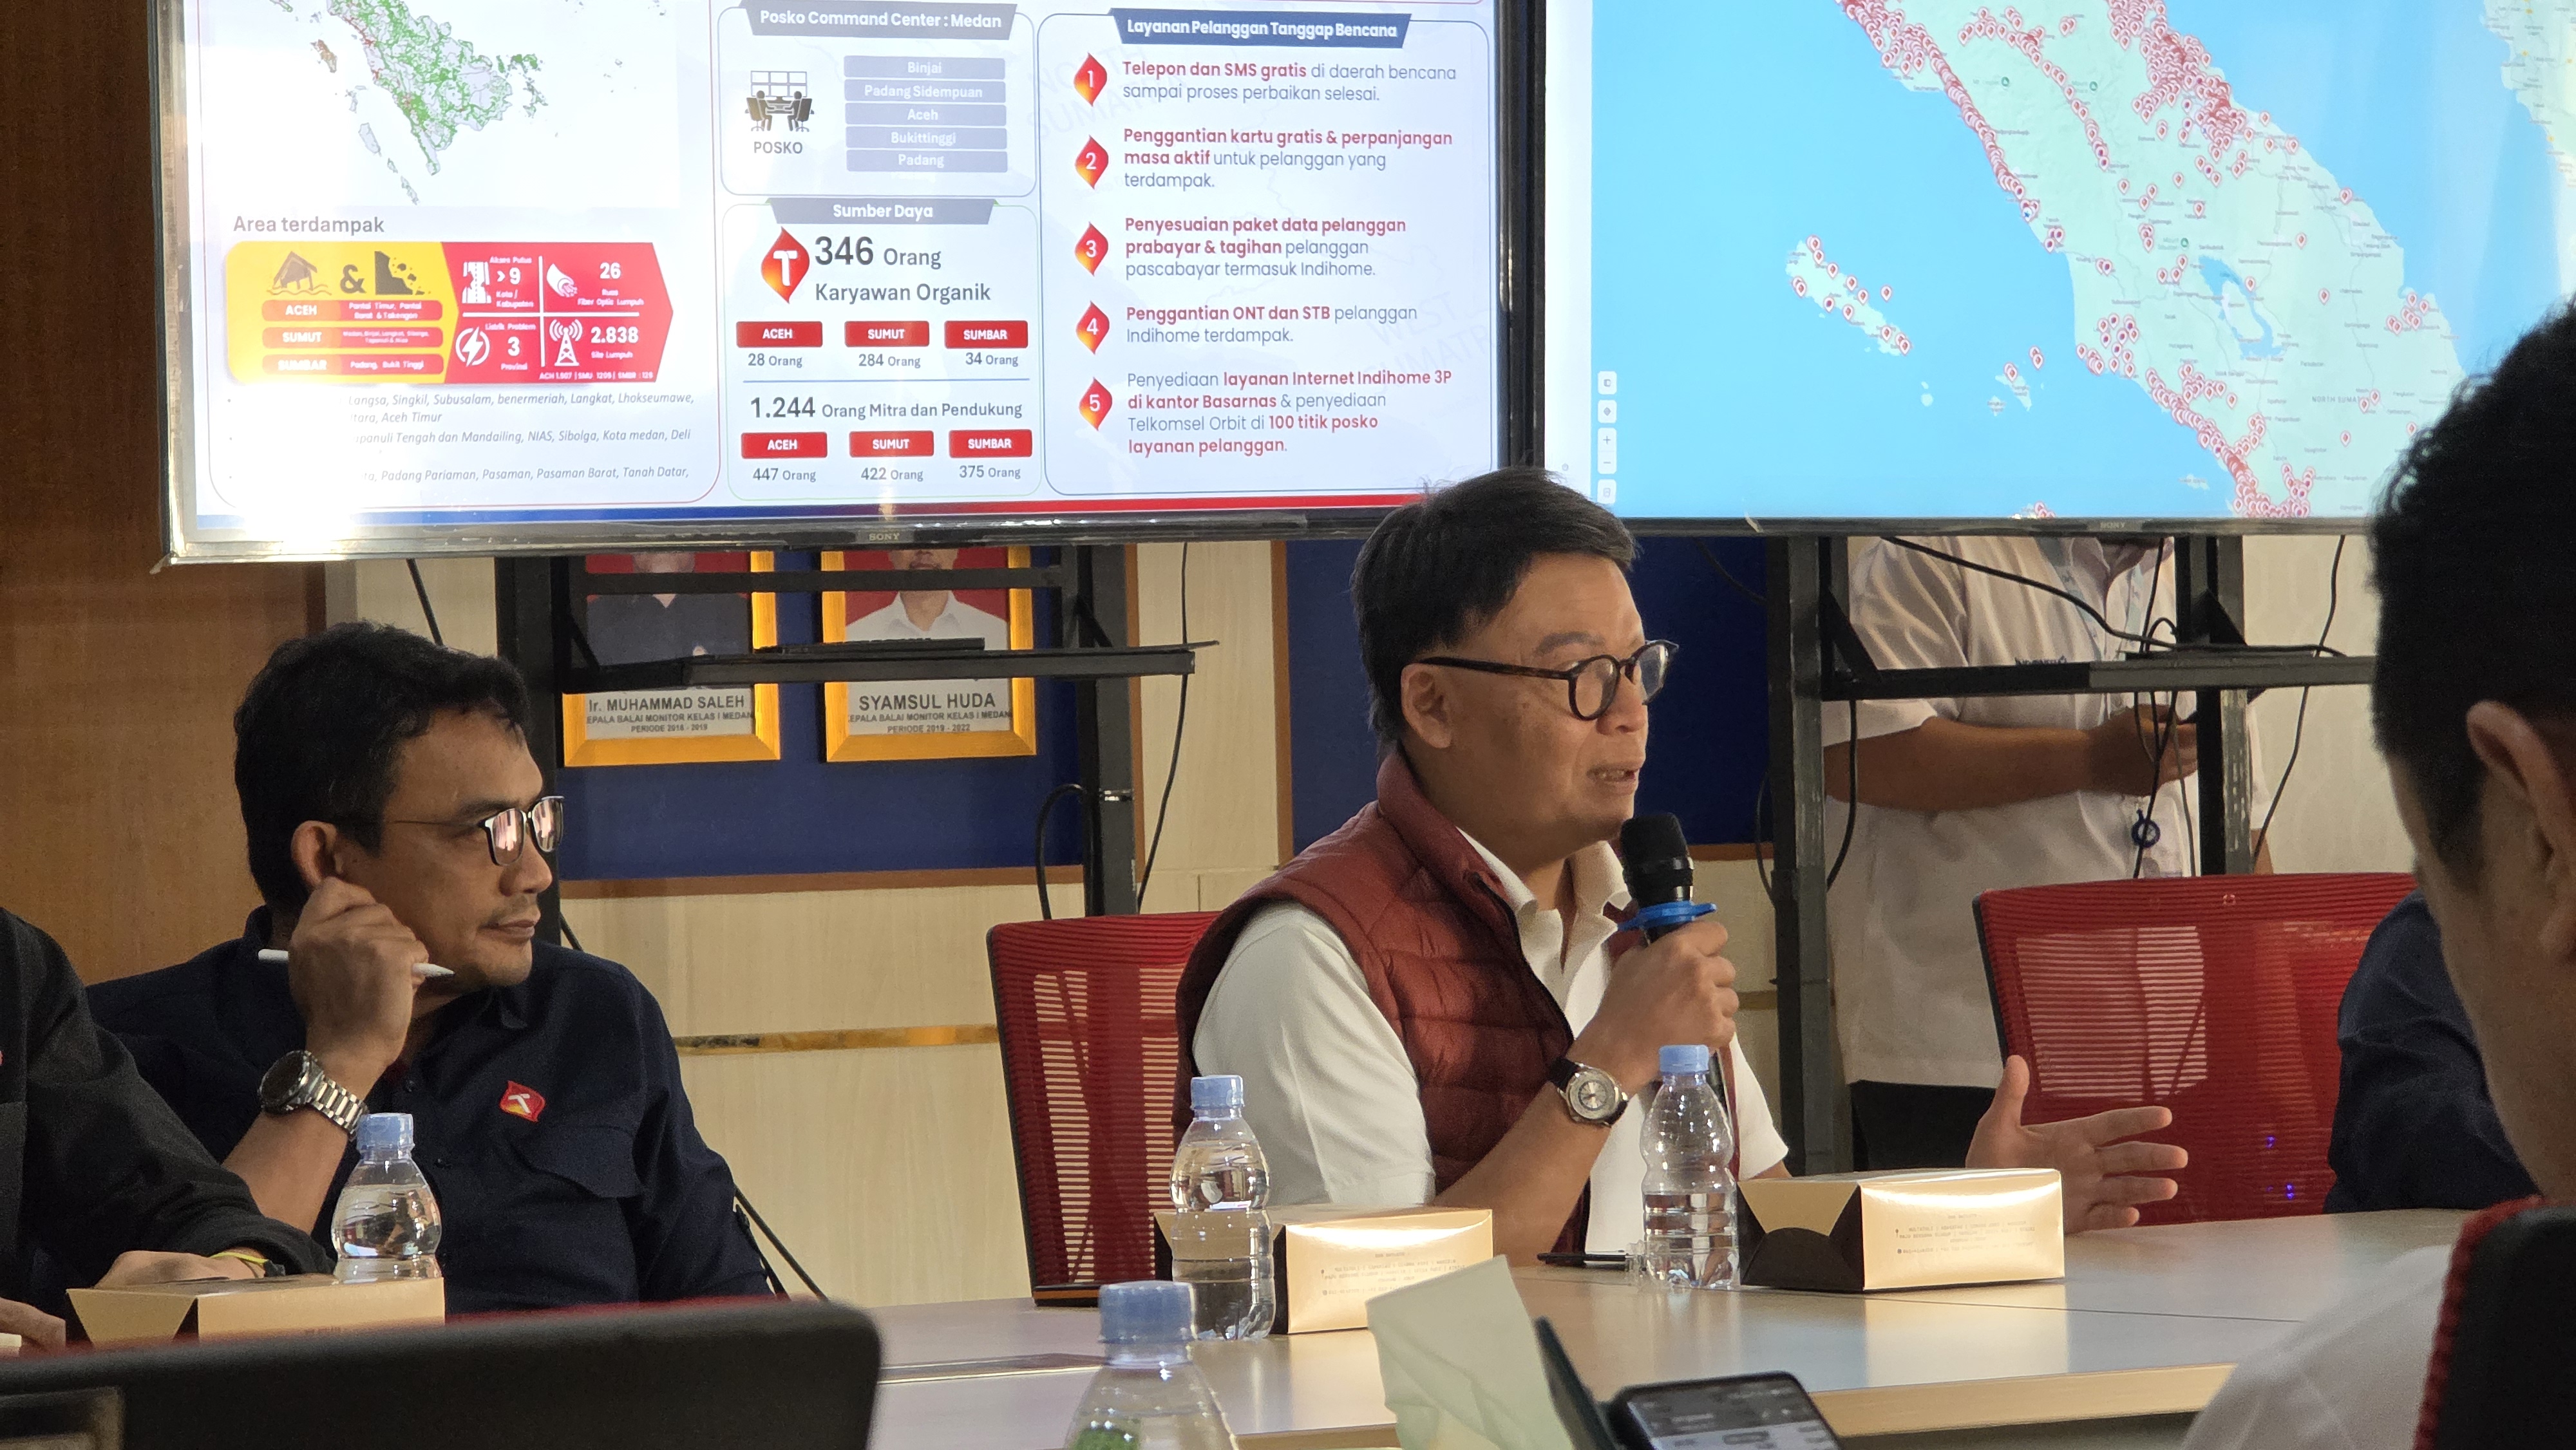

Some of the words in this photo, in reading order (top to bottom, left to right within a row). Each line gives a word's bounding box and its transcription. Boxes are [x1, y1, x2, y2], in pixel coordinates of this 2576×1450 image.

[760, 10, 805, 24] Posko
[808, 11, 888, 26] Command
[890, 13, 941, 26] Center
[951, 14, 1001, 28] Medan
[1127, 19, 1190, 38] Layanan
[1191, 20, 1268, 39] Pelanggan
[1270, 21, 1333, 40] Tanggap
[1335, 23, 1397, 39] Bencana
[907, 62, 942, 75] Binjai
[1122, 61, 1186, 80] Telepon
[1189, 62, 1220, 77] dan
[1224, 62, 1257, 77] SMS
[1261, 62, 1307, 82] gratis
[1311, 64, 1326, 80] di
[1329, 64, 1385, 80] daerah
[1388, 65, 1456, 80] bencana
[864, 84, 911, 99] Padang
[913, 85, 983, 99] Sidempuan
[1122, 84, 1183, 101] sampai
[1186, 86, 1238, 102] proses
[1242, 84, 1320, 103] perbaikan
[1324, 86, 1381, 102] selesai.
[907, 109, 939, 120] Aceh
[891, 132, 956, 146] Bukittinggi
[1123, 128, 1227, 147] Penggantian
[1230, 129, 1273, 144] kartu
[1276, 129, 1323, 147] gratis
[1341, 129, 1452, 149] perpanjangan
[753, 142, 803, 154] POSKO
[898, 154, 945, 167] Padang
[1124, 150, 1171, 165] masa
[1173, 149, 1211, 165] aktif
[1213, 150, 1256, 166] untuk
[1260, 151, 1345, 170] pelanggan
[1348, 153, 1386, 171] yang
[1124, 172, 1215, 191] terdampak.
[833, 204, 892, 218] Sumber
[894, 205, 933, 221] Daya
[233, 216, 277, 232] Area
[281, 216, 384, 236] terdampak
[1125, 218, 1229, 236] Penyesuaian
[1233, 218, 1278, 236] paket
[1281, 218, 1318, 232] data
[1321, 218, 1406, 236] pelanggan
[815, 236, 874, 266] 346
[884, 249, 941, 270] Orang
[1125, 240, 1202, 258] prabayar
[1220, 240, 1282, 258] tagihan
[1285, 240, 1368, 258] pelanggan
[340, 264, 367, 294] &
[509, 267, 521, 285] 9
[600, 262, 621, 279] 26
[1126, 262, 1221, 280] pascabayar
[1224, 261, 1297, 276] termasuk
[1301, 261, 1376, 276] Indihome.
[815, 283, 911, 305] Karyawan
[916, 283, 990, 305] Organik
[285, 305, 317, 315] ACEH
[1127, 306, 1229, 326] Penggantian
[1232, 306, 1265, 321] ONT
[1269, 306, 1298, 321] dan
[1302, 306, 1331, 321] STB
[1334, 305, 1417, 325] pelanggan
[282, 332, 322, 343] SUMUT
[591, 326, 639, 343] 2.838
[762, 328, 793, 340] ACEH
[867, 328, 905, 340] SUMUT
[963, 329, 1008, 341] SUMBAR
[1127, 328, 1200, 344] Indihome
[1204, 327, 1294, 347] terdampak.
[507, 336, 520, 357] 3
[278, 360, 327, 371] SUMBAR
[748, 353, 765, 367] 28
[768, 356, 802, 368] Orang
[858, 353, 884, 367] 284
[887, 356, 921, 369] Orang
[965, 352, 983, 366] 34
[985, 355, 1019, 367] Orang
[1128, 372, 1220, 392] Penyediaan
[1224, 371, 1288, 390] layanan
[1292, 371, 1354, 386] Internet
[1358, 370, 1431, 386] Indihome
[1434, 370, 1452, 384] 3P
[392, 393, 430, 408] Singkil,
[433, 393, 495, 406] Subusalam,
[497, 393, 567, 406] benermeriah,
[570, 392, 615, 407] Langkat,
[618, 391, 695, 406] Lhokseumawe,
[1128, 394, 1142, 409] di
[1146, 394, 1199, 409] kantor
[1202, 394, 1277, 408] Basarnas
[1295, 393, 1386, 412] penyediaan
[381, 411, 408, 423] Aceh
[412, 411, 442, 423] Timur
[750, 397, 816, 419] 1.244
[822, 404, 866, 420] Orang
[869, 404, 907, 417] Mitra
[911, 404, 938, 417] dan
[942, 403, 1022, 419] Pendukung
[1128, 415, 1205, 432] Telkomsel
[1208, 415, 1247, 431] Orbit
[1250, 415, 1265, 431] di
[1269, 415, 1294, 430] 100
[1298, 414, 1328, 430] titik
[1332, 414, 1378, 434] posko
[396, 431, 435, 446] Tengah
[437, 431, 459, 443] dan
[460, 430, 525, 445] Mandailing,
[527, 430, 556, 444] NIAS,
[558, 429, 600, 444] Sibolga,
[602, 429, 627, 441] Kota
[629, 429, 668, 442] medan,
[670, 428, 691, 440] Deli
[767, 440, 798, 451] ACEH
[872, 439, 909, 450] SUMUT
[967, 438, 1012, 449] SUMBAR
[1128, 438, 1195, 458] layanan
[1198, 438, 1287, 457] pelanggan.
[381, 469, 422, 484] Padang
[424, 468, 479, 483] Pariaman,
[482, 468, 534, 482] Pasaman,
[536, 467, 585, 479] Pasaman
[587, 467, 619, 481] Barat,
[622, 466, 654, 478] Tanah
[657, 466, 689, 480] Datar,
[752, 467, 779, 481] 447
[782, 470, 817, 482] Orang
[860, 467, 887, 481] 422
[890, 469, 923, 482] Orang
[959, 465, 985, 478] 375
[988, 467, 1021, 480] Orang
[869, 532, 900, 541] SONY
[589, 699, 602, 712] Ir.
[607, 697, 693, 711] MUHAMMAD
[697, 695, 744, 708] SALEH
[858, 694, 942, 711] SYAMSUL
[947, 693, 996, 708] HUDA
[618, 715, 643, 723] BALAI
[645, 713, 685, 722] MONITOR
[687, 712, 715, 720] KELAS
[879, 713, 904, 722] BALAI
[947, 711, 974, 720] KELAS
[631, 724, 665, 733] PERIODE
[887, 725, 924, 734] PERIODE
